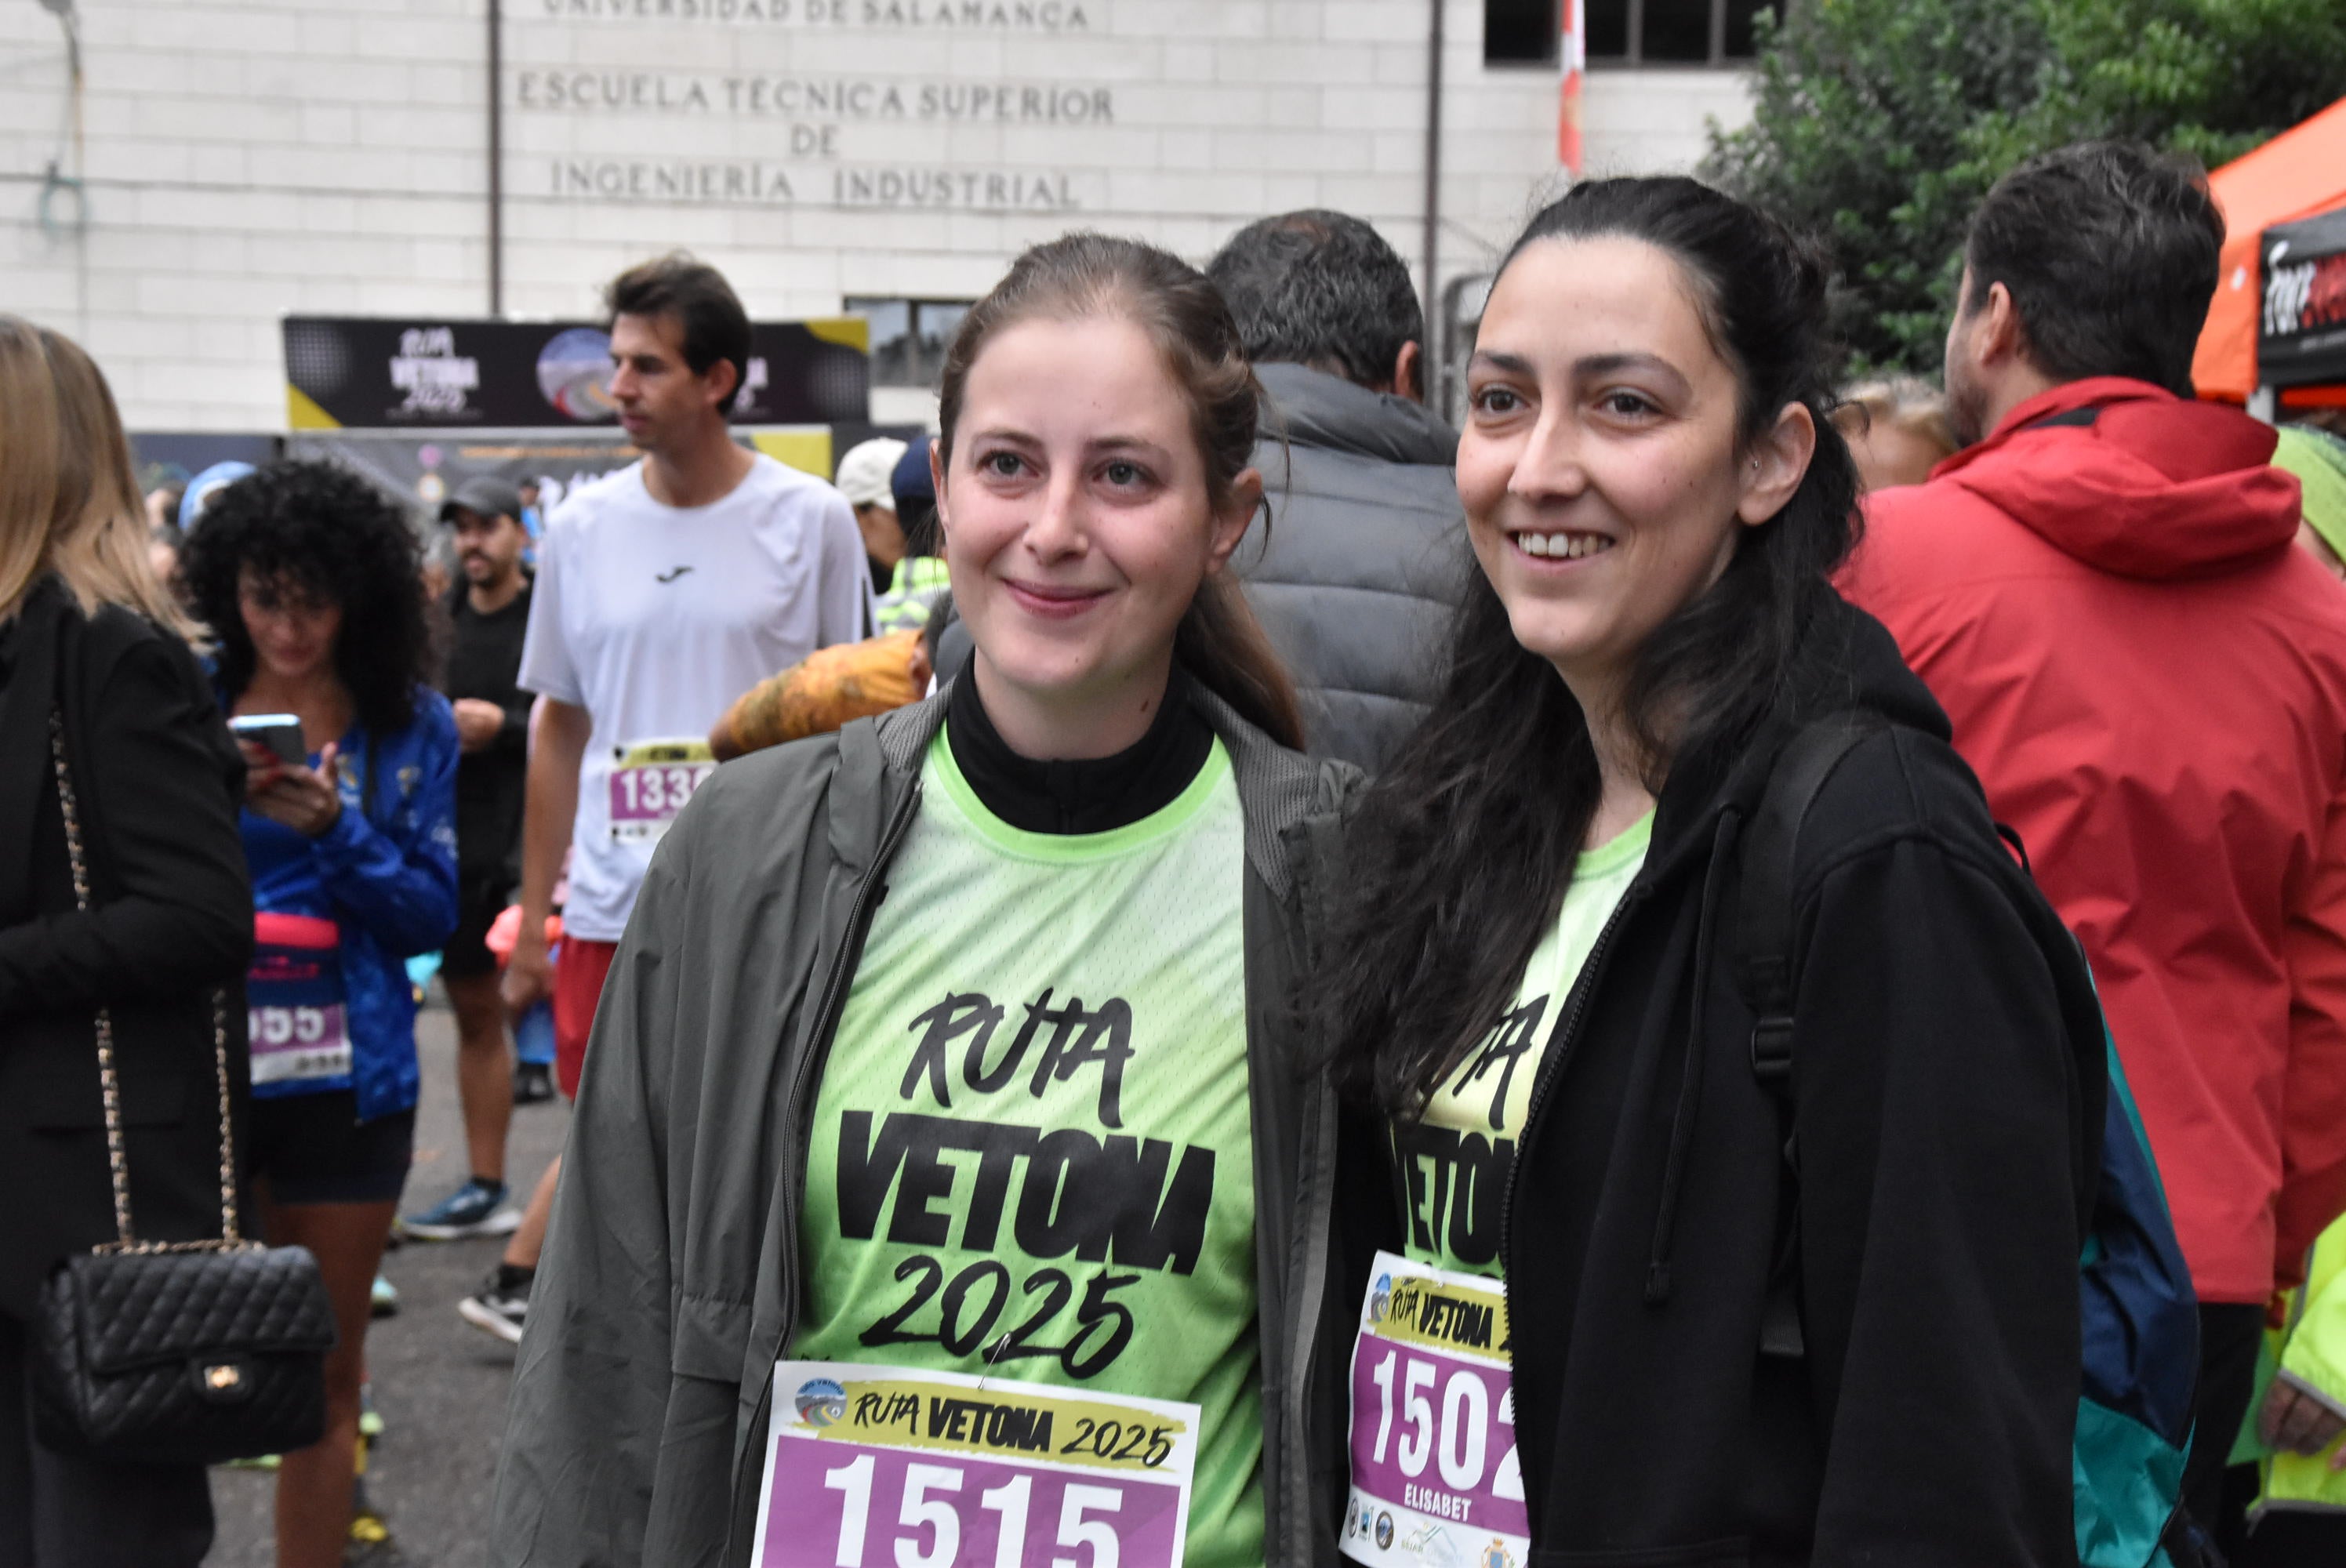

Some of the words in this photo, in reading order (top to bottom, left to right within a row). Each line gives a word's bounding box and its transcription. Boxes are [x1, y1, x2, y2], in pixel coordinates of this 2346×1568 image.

[519, 71, 710, 111] ESCUELA
[918, 82, 1114, 122] SUPERIOR
[790, 122, 839, 158] DE
[833, 167, 1080, 209] INDUSTRIAL
[899, 987, 1135, 1128] RUTA
[837, 1110, 1216, 1276] VETONA
[859, 1255, 1140, 1379] 2025
[1389, 1288, 1419, 1332] RUTA
[1418, 1293, 1494, 1350] VETONA
[853, 1391, 921, 1436] RUTA
[928, 1396, 1054, 1453] VETONA
[1060, 1418, 1173, 1468] 2025
[823, 1454, 1124, 1568] 1515
[1404, 1483, 1472, 1523] ELISABET
